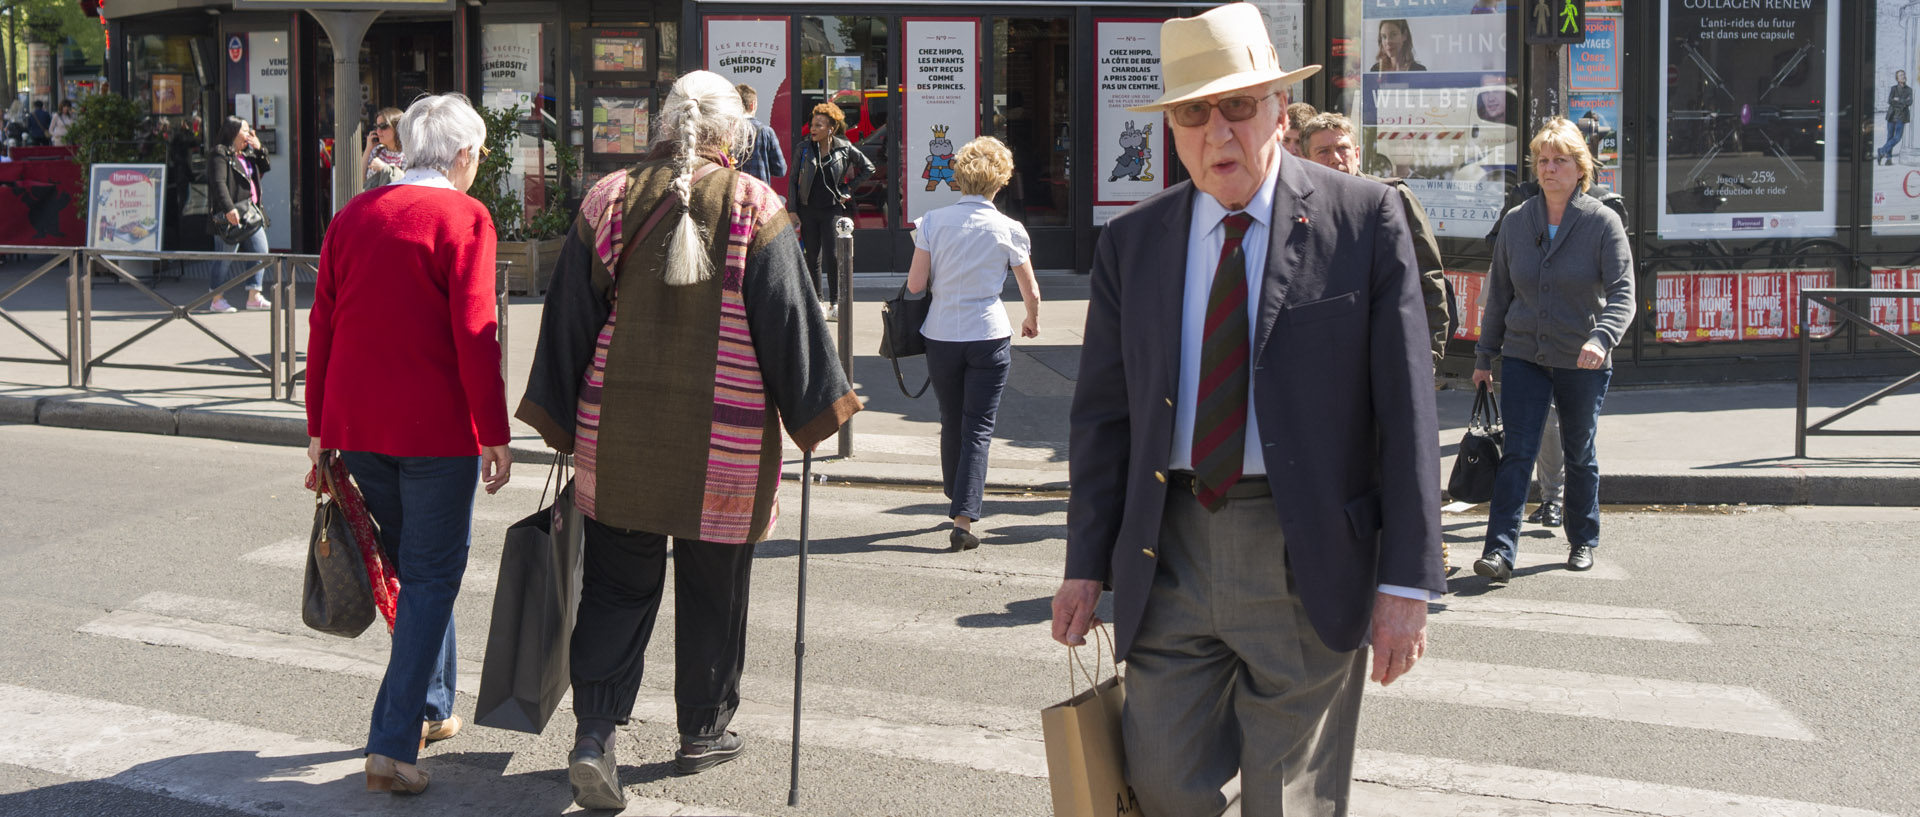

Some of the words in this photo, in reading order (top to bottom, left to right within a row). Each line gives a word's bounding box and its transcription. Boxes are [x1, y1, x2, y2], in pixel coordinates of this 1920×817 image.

[1765, 0, 1812, 9] RENEW
[1585, 22, 1615, 33] xploré
[1700, 17, 1755, 28] L'anti-rides
[1757, 17, 1770, 28] du
[1772, 17, 1796, 28] futur
[1700, 31, 1714, 39] est
[1716, 29, 1739, 39] dans
[1741, 31, 1758, 39] une
[1760, 29, 1795, 41] capsule
[493, 45, 530, 54] RECETTES
[715, 43, 731, 51] LES
[735, 41, 780, 51] RECETTES
[938, 48, 964, 56] HIPPO,
[719, 54, 776, 67] GÉNÉROSITÉ
[1112, 56, 1128, 64] CÔTE
[1581, 51, 1605, 61] Osez
[481, 60, 528, 72] GÉNÉROSITÉ
[733, 65, 763, 74] HIPPO
[491, 70, 516, 78] HIPPO
[1372, 88, 1430, 109] WILL
[1439, 88, 1468, 108] BE
[1450, 144, 1506, 165] FINE
[1715, 175, 1745, 186] Jusqu'à
[1746, 171, 1776, 184] -25%
[1426, 181, 1443, 190] WIM
[1703, 187, 1714, 196] de
[1716, 186, 1753, 195] réduction
[1755, 186, 1765, 195] de
[1442, 208, 1455, 218] LE
[1462, 209, 1476, 218] 22
[1656, 278, 1674, 298] OUT
[1675, 278, 1686, 298] LE
[1698, 277, 1721, 297] TOUT
[1723, 277, 1733, 297] LE
[1747, 276, 1770, 296] TOUT
[1771, 276, 1781, 296] LE
[1699, 297, 1733, 312] MONDE
[1748, 296, 1782, 310] MONDE
[1699, 311, 1716, 328] LIT
[1748, 310, 1765, 326] LIT
[1656, 328, 1689, 340] ociety
[1696, 327, 1736, 339] Society
[1746, 326, 1785, 337] Society
